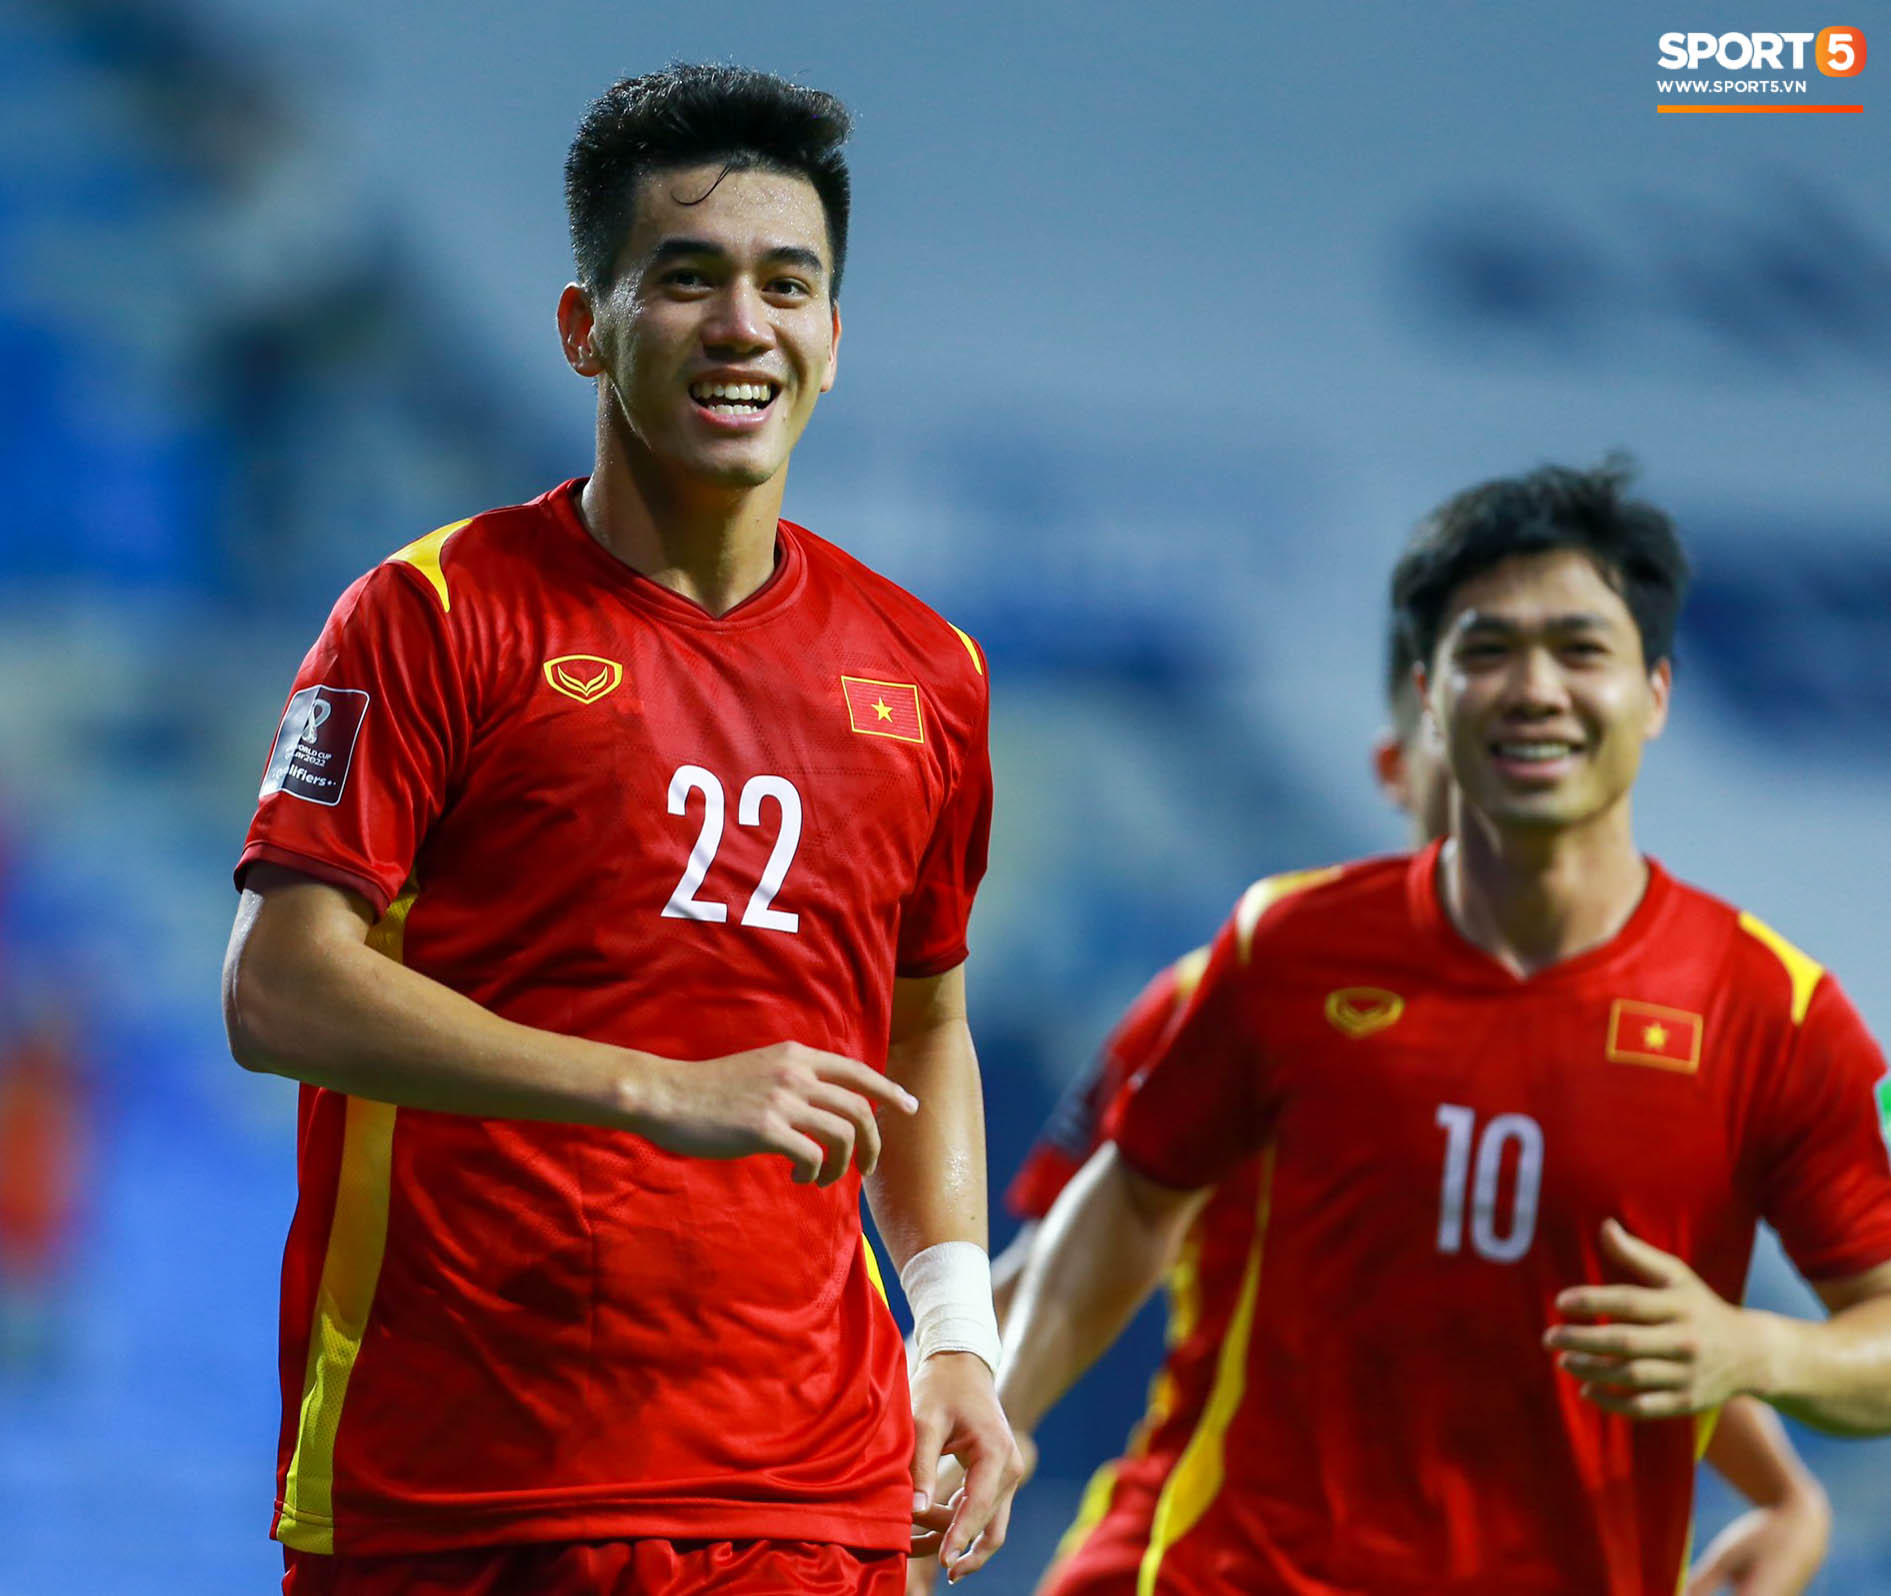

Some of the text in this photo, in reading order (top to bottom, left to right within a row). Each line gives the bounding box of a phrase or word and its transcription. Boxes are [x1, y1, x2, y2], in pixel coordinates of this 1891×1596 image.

[275, 764, 327, 786] lifiers
[293, 744, 318, 757] ORLD
[318, 751, 332, 761] CUP
[660, 765, 803, 933] 22
[1436, 1103, 1544, 1263] 10
